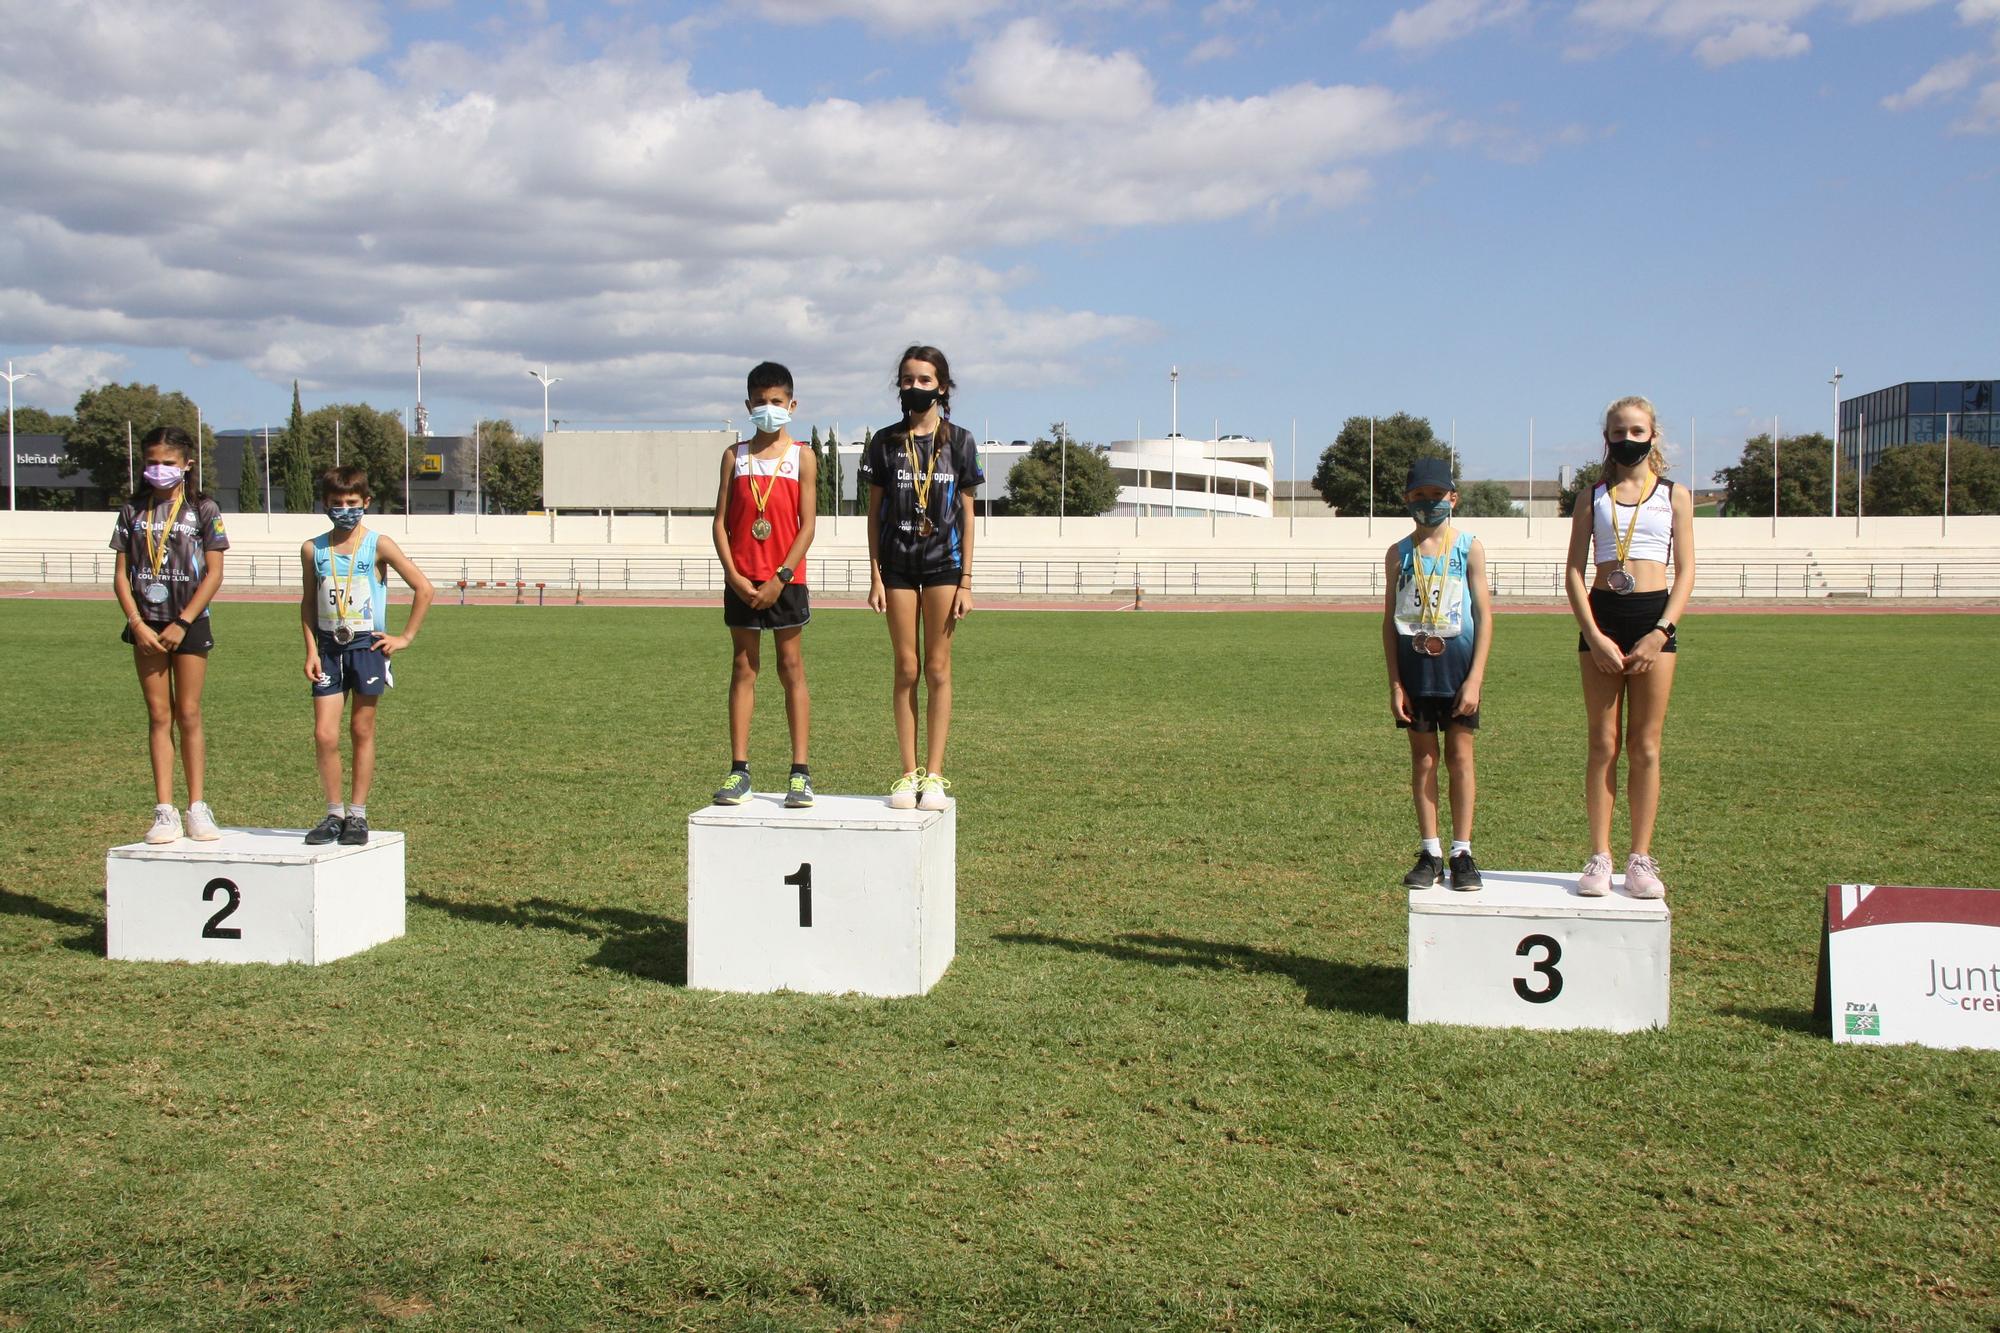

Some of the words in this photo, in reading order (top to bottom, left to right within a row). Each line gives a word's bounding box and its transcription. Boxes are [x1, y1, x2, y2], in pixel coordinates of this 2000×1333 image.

[17, 452, 47, 464] Isleña
[1414, 588, 1440, 608] 53
[202, 878, 241, 939] 2
[784, 863, 812, 927] 1
[1513, 934, 1563, 1003] 3
